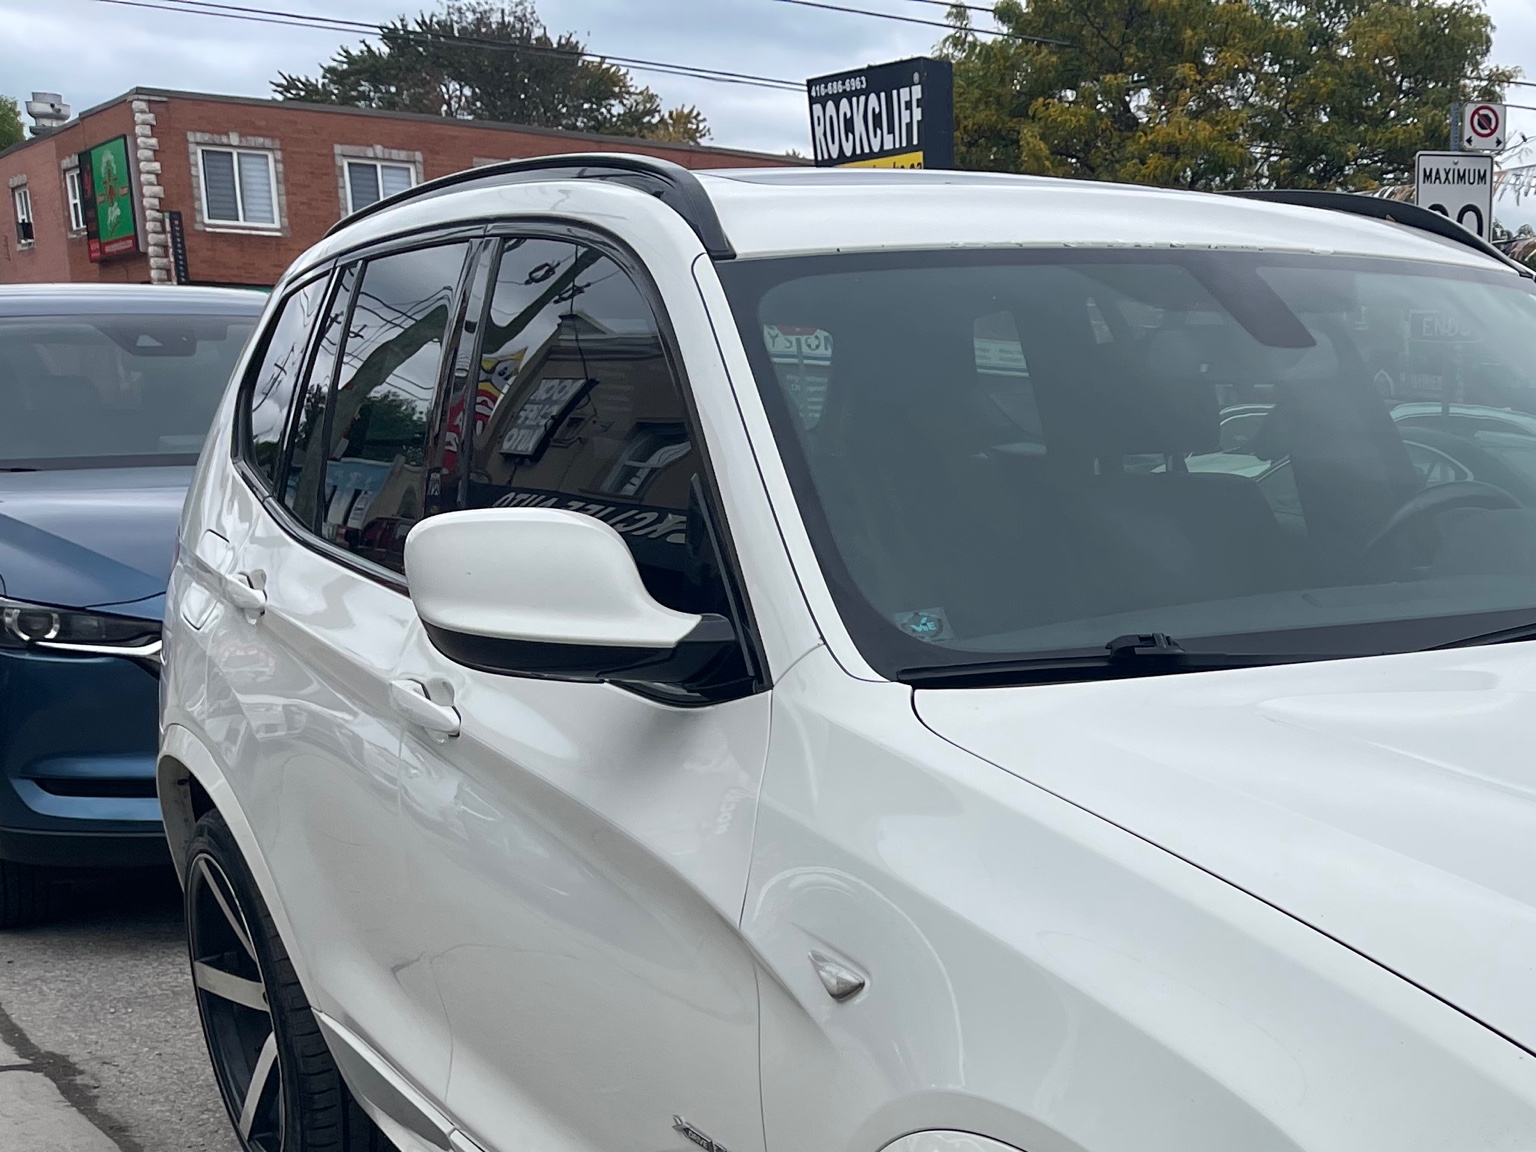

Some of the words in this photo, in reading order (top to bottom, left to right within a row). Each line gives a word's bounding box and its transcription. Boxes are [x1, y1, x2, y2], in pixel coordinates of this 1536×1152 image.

[811, 76, 867, 98] 416-686-6963
[812, 84, 922, 161] ROCKCLIFF
[1422, 167, 1487, 185] MAXIMUM
